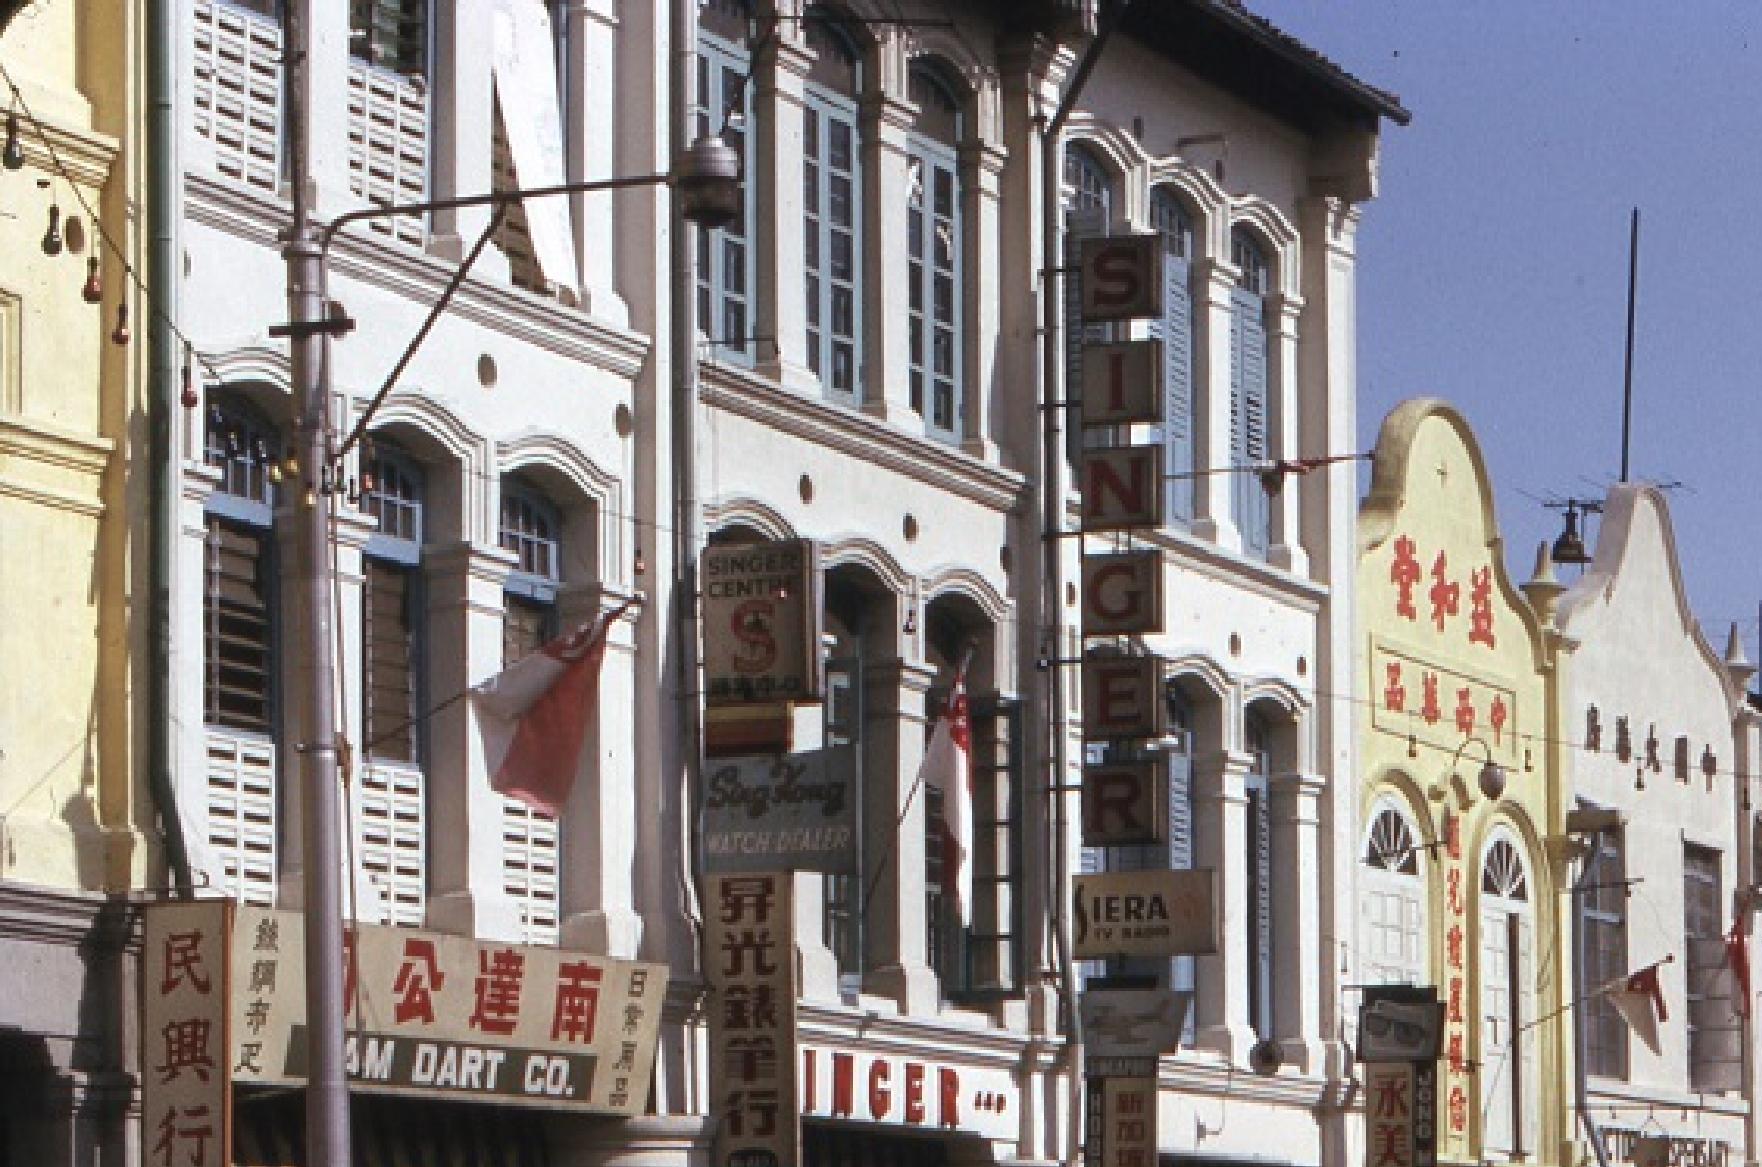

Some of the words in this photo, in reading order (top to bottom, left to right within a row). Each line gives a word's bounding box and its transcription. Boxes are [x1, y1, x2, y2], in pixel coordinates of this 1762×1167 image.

[708, 555, 799, 577] SINGER
[1090, 247, 1146, 830] SINGER
[1390, 535, 1495, 650] 益和堂
[1074, 884, 1170, 945] SIERA
[414, 1051, 505, 1093] DART
[522, 1053, 575, 1097] CO.
[803, 1049, 961, 1128] INGER
